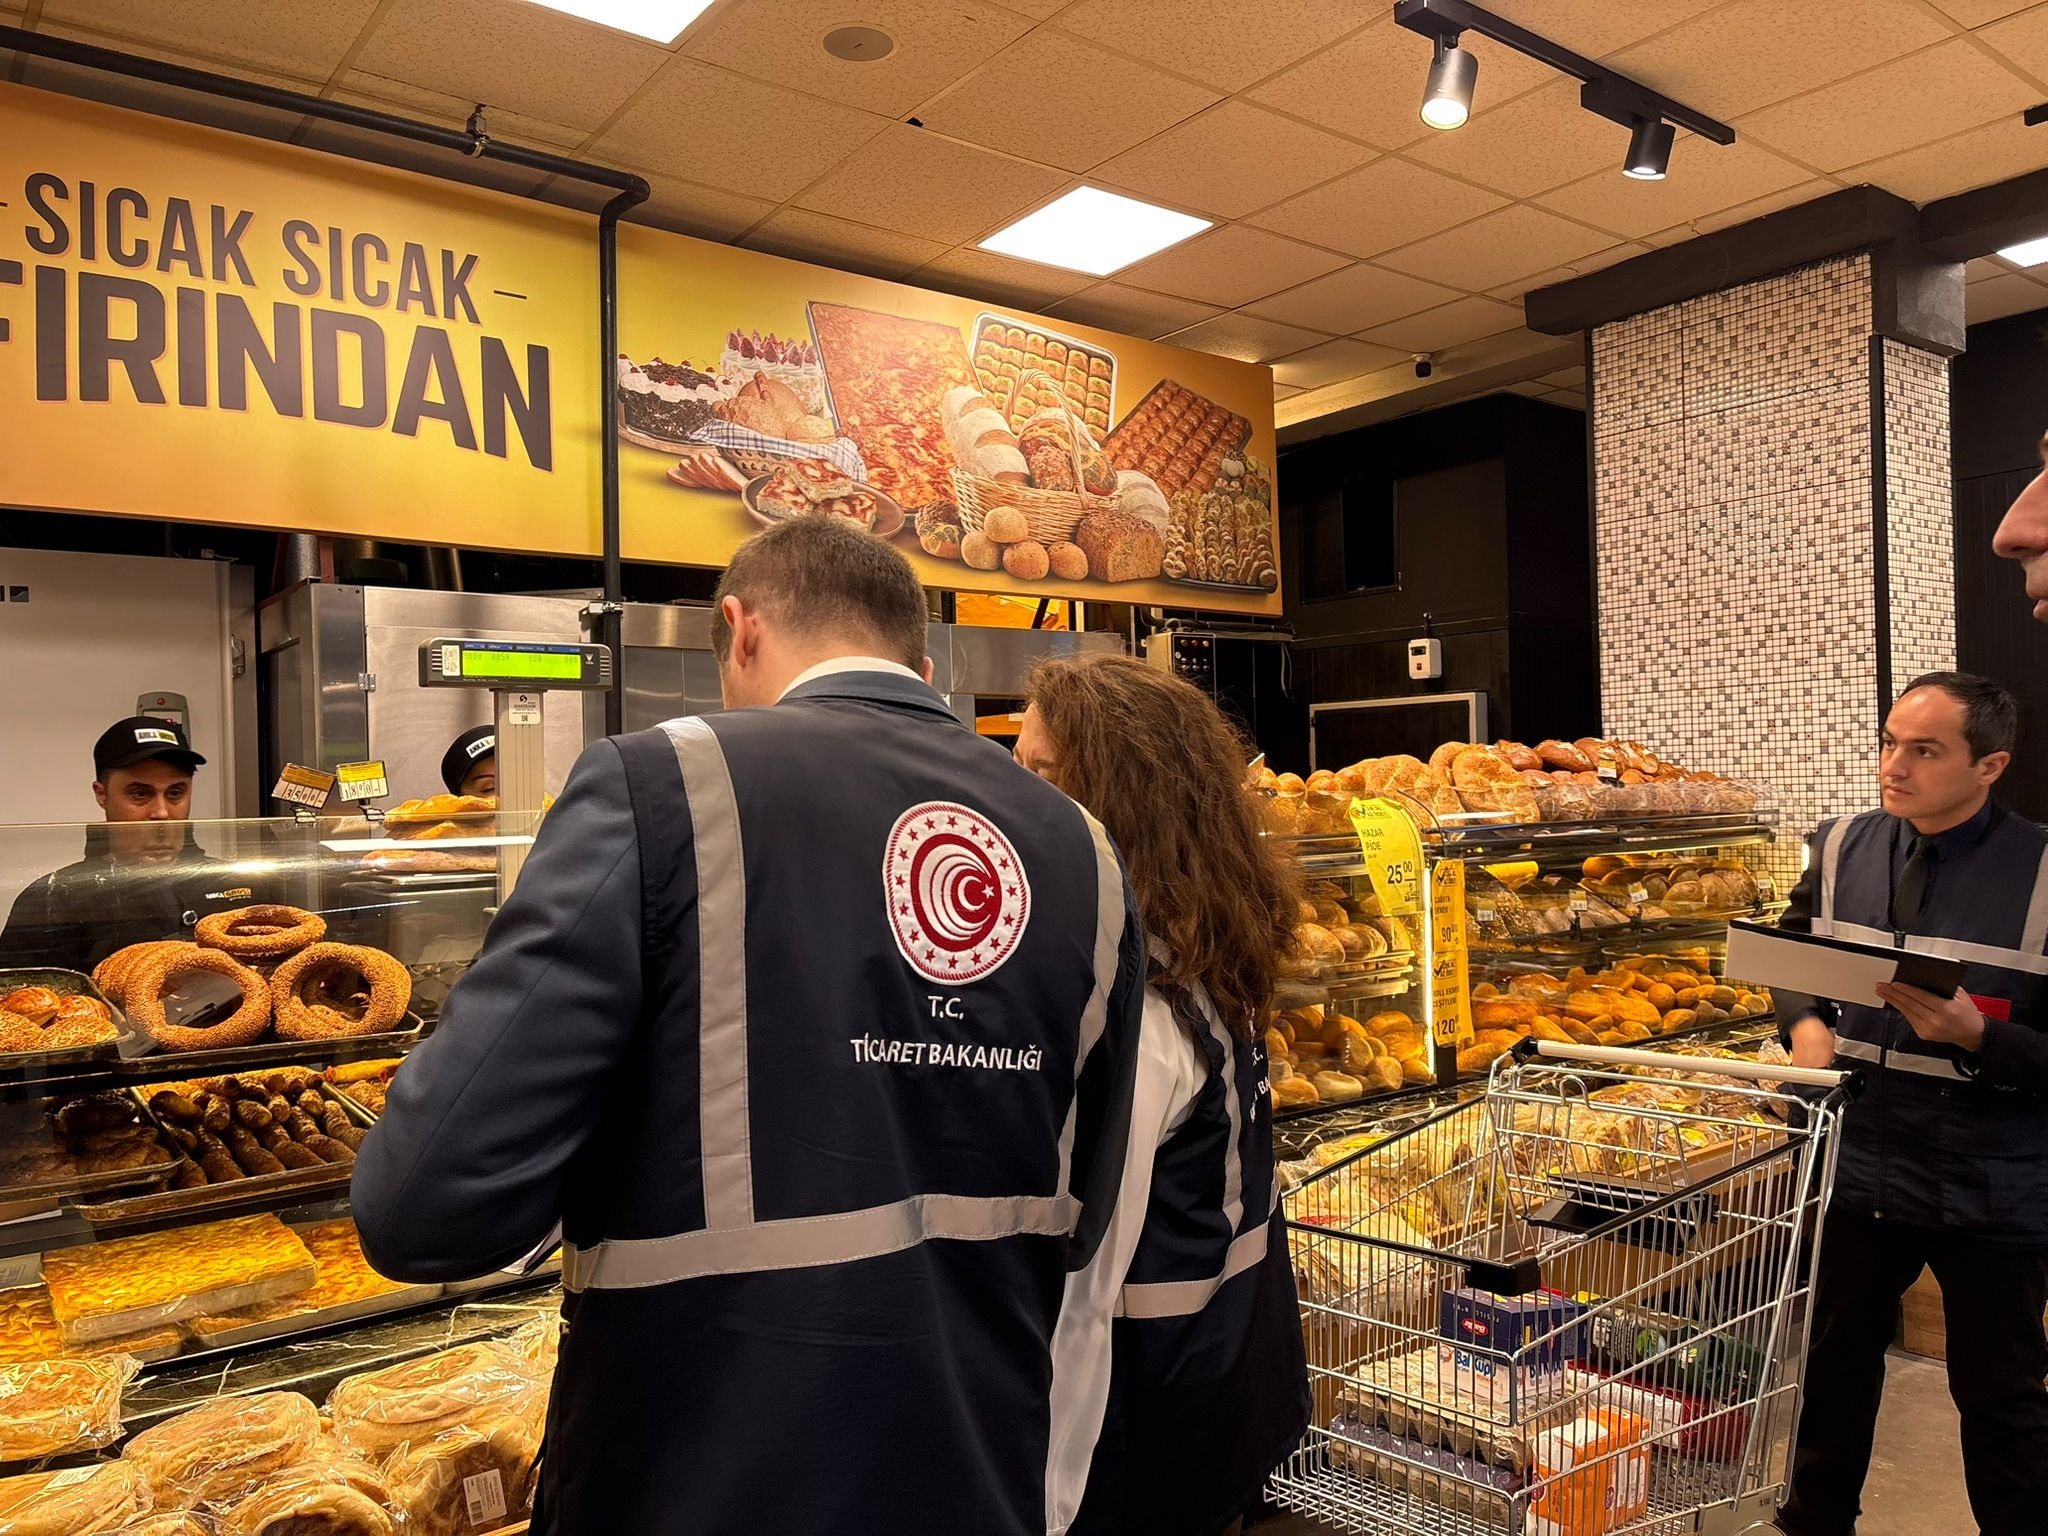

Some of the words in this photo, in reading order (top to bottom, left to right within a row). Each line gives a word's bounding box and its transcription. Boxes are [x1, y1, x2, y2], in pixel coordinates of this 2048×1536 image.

[24, 172, 256, 287] SICAK
[281, 219, 481, 325] SICAK
[469, 741, 486, 755] ANKA
[1360, 828, 1384, 838] HAZAR
[1365, 840, 1382, 851] PİDE
[1387, 864, 1403, 885] 25
[1441, 927, 1452, 943] 90
[927, 995, 964, 1020] T.C.
[1436, 1018, 1455, 1036] 120
[850, 1031, 926, 1065] TİCARET
[929, 1043, 1042, 1072] BAKANLIĞI
[1456, 1352, 1471, 1367] Bal
